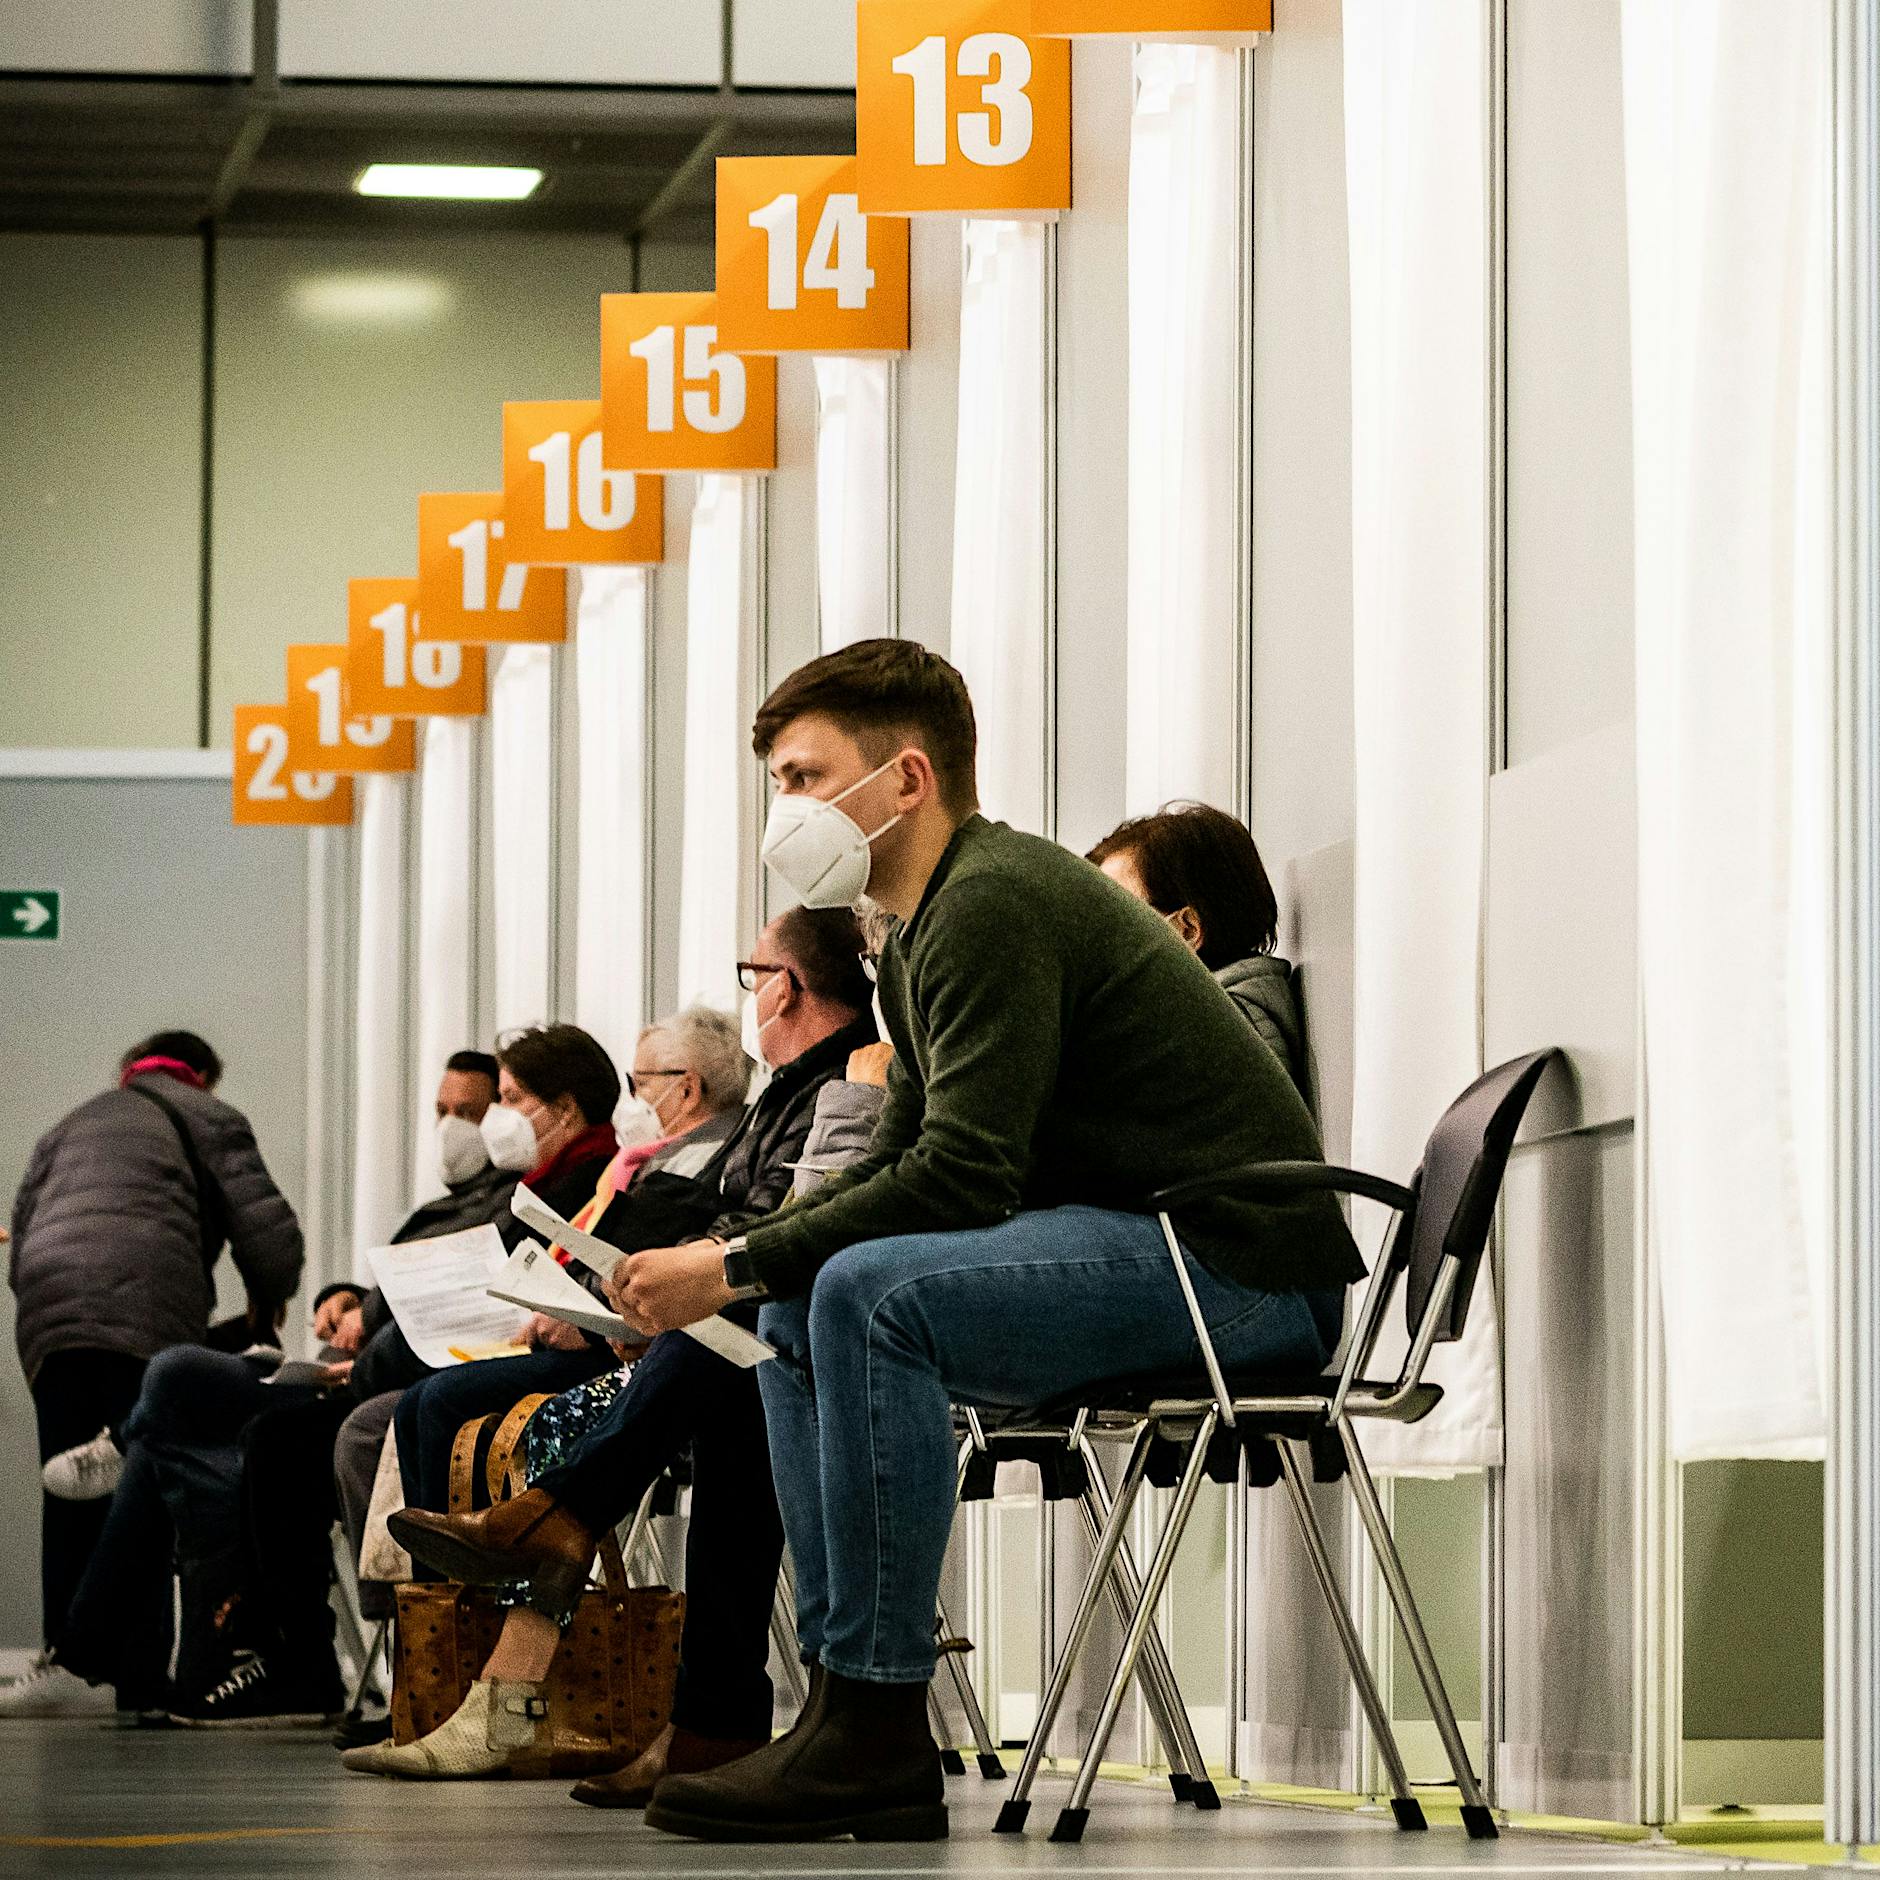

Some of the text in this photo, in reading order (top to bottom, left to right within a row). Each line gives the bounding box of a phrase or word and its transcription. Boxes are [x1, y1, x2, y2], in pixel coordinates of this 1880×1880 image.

[892, 32, 1033, 167] 13
[748, 193, 875, 310] 14
[629, 325, 746, 434] 15
[527, 431, 636, 531] 16
